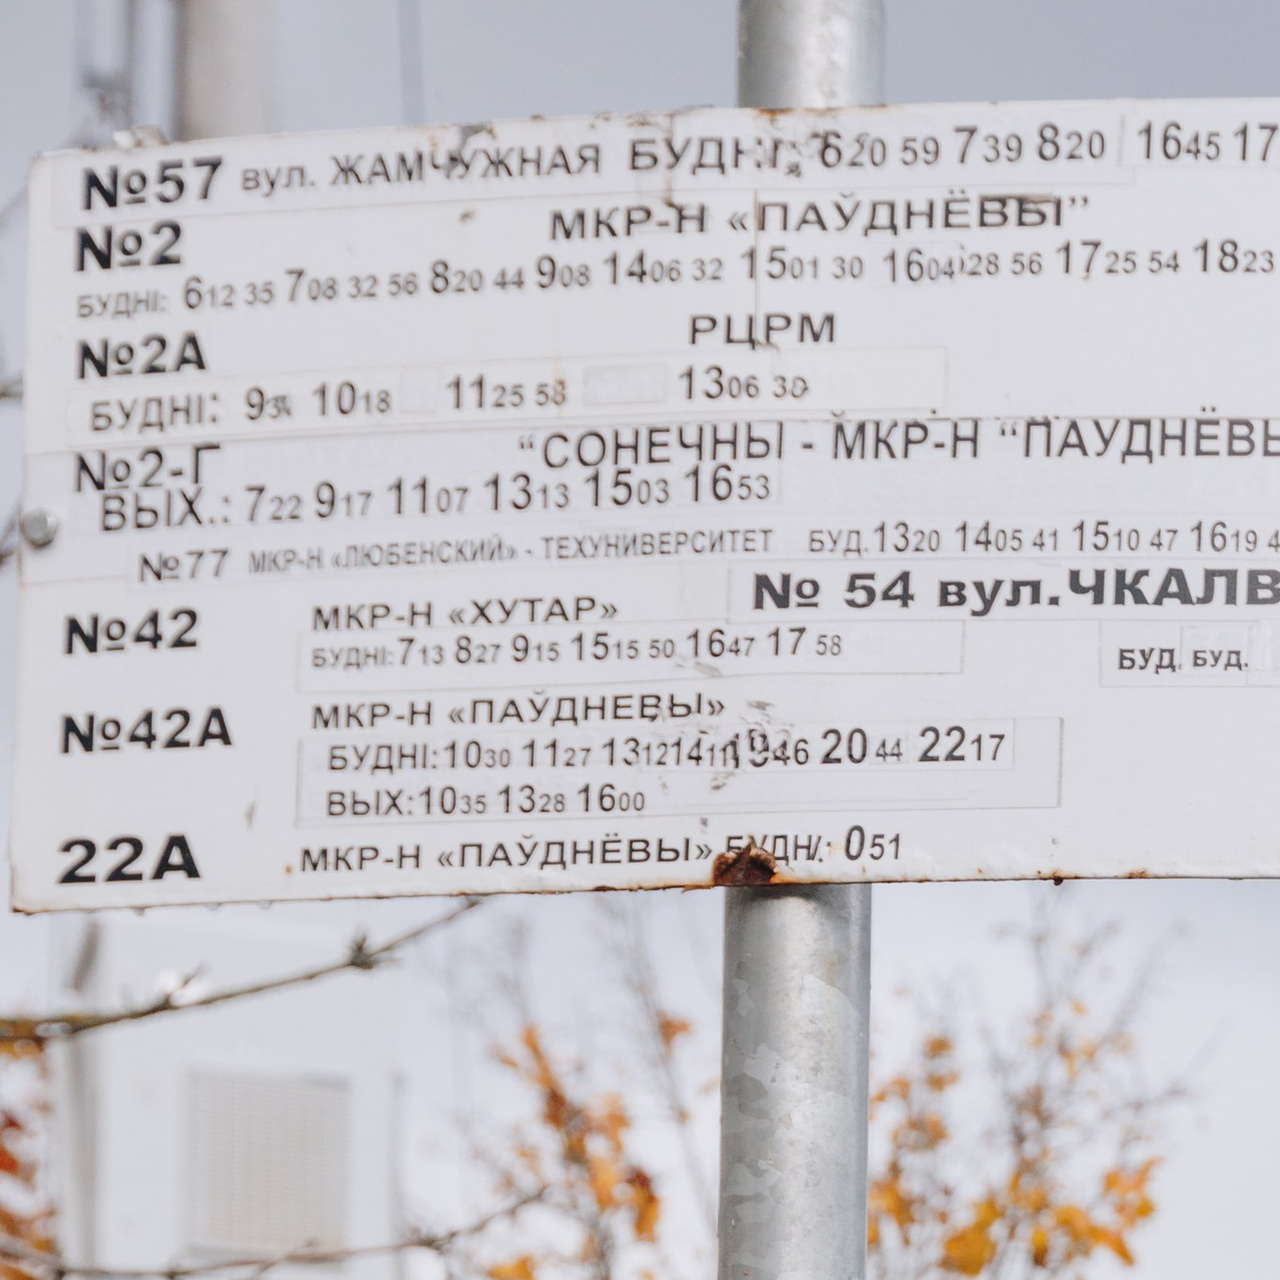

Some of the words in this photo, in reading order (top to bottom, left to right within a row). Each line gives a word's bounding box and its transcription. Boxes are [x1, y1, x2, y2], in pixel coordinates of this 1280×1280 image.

[81, 154, 223, 211] №57
[242, 166, 315, 198] вул.
[330, 145, 600, 183] ЖАМЧУЖНАЯ
[900, 136, 940, 167] 59
[953, 125, 1023, 165] 739
[1036, 122, 1106, 162] 820
[1138, 120, 1221, 161] 1645
[74, 219, 183, 273] №2
[550, 203, 708, 241] МКР-Н
[183, 275, 234, 311] 612
[246, 281, 275, 306] 35
[286, 268, 338, 302] 708
[349, 274, 378, 299] 32
[389, 272, 419, 297] 56
[430, 259, 484, 295] 820
[493, 268, 525, 290] 44
[535, 254, 591, 290] 908
[604, 249, 682, 286] 1406
[692, 258, 723, 282] 32
[741, 245, 818, 280] 1501
[832, 256, 864, 280] 30
[883, 247, 954, 283] 1604
[1011, 252, 1043, 276] 56
[1056, 239, 1137, 279] 1725
[1148, 250, 1180, 274] 54
[1194, 238, 1275, 274] 1823
[76, 331, 208, 381] №2А
[689, 312, 835, 352] РЦРМ
[91, 393, 218, 434] БУДНІ:
[313, 381, 391, 417] 1018
[447, 374, 524, 410] 1125
[679, 364, 760, 401] 1306
[74, 441, 222, 495] №2-Г
[519, 420, 784, 471] “СОНЕЧНЫ
[95, 485, 230, 533] ВЫХ.:
[245, 484, 302, 523] 722
[314, 480, 372, 519] 917
[387, 475, 469, 515] 1107
[484, 471, 570, 512] 1313
[583, 466, 670, 508] 1503
[684, 457, 770, 503] 1653
[139, 548, 229, 583] №77
[250, 549, 322, 573] МКР-Н
[541, 529, 773, 561] ТЕХУНИВЕРСИТЕТ
[955, 520, 1023, 553] 1405
[1031, 528, 1058, 552] 41
[1072, 520, 1140, 552] 1510
[1149, 528, 1179, 551] 47
[1190, 520, 1258, 553] 1619
[312, 601, 433, 631] МКР-Н
[448, 596, 618, 625] «ХУТАР»
[752, 572, 821, 611] №
[843, 570, 916, 610] 54
[63, 607, 199, 656] №42
[454, 635, 502, 665] 827
[511, 633, 560, 663] 915
[570, 631, 639, 661] 1515
[648, 638, 675, 659] 50
[686, 627, 756, 659] 1647
[1192, 649, 1249, 672] БУД.
[60, 705, 233, 755] №42А
[312, 700, 432, 730] МКР-Н
[522, 738, 592, 768] 1127
[917, 725, 1006, 763] 2217
[497, 784, 566, 814] 1328
[577, 782, 646, 813] 1600
[56, 833, 202, 885] 22А
[300, 844, 421, 872] МКР-Н
[438, 833, 714, 871] «ПАЎДНЁВЫ»
[843, 824, 900, 862] 051
